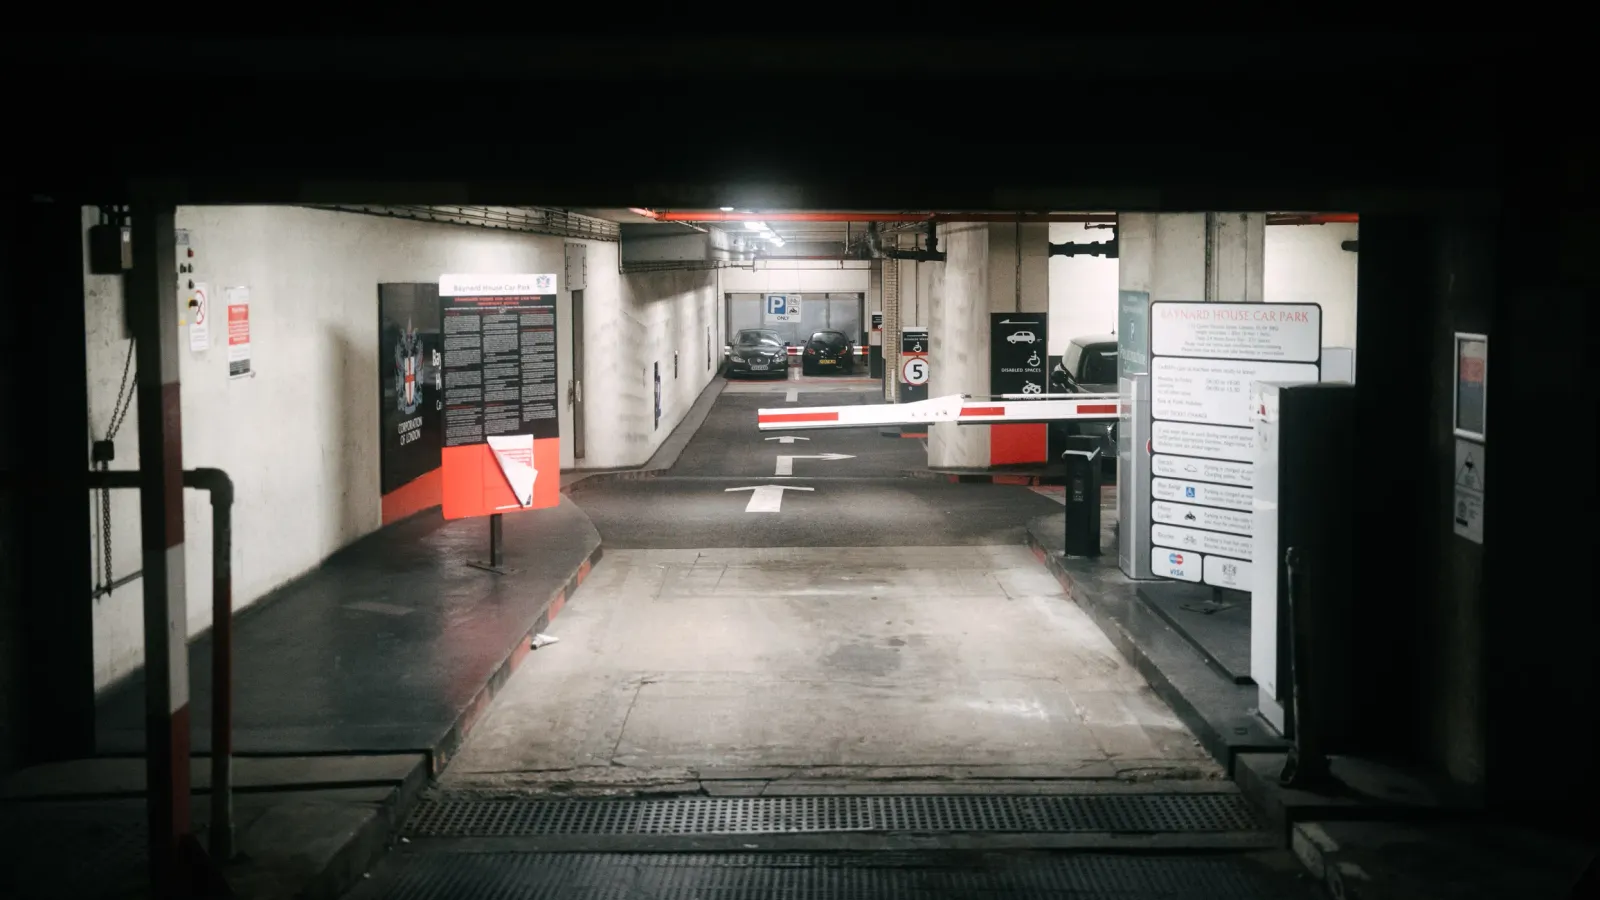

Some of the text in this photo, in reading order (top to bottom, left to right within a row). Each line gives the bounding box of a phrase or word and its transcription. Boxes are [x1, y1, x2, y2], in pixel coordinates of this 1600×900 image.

[770, 296, 784, 314] P
[1212, 309, 1249, 322] HOUSE
[1252, 310, 1276, 322] CAR
[1279, 311, 1309, 323] PARK
[913, 364, 923, 380] 5
[398, 416, 423, 434] CORPORATION
[400, 428, 421, 446] OF LONDON
[1170, 569, 1184, 577] VISA
